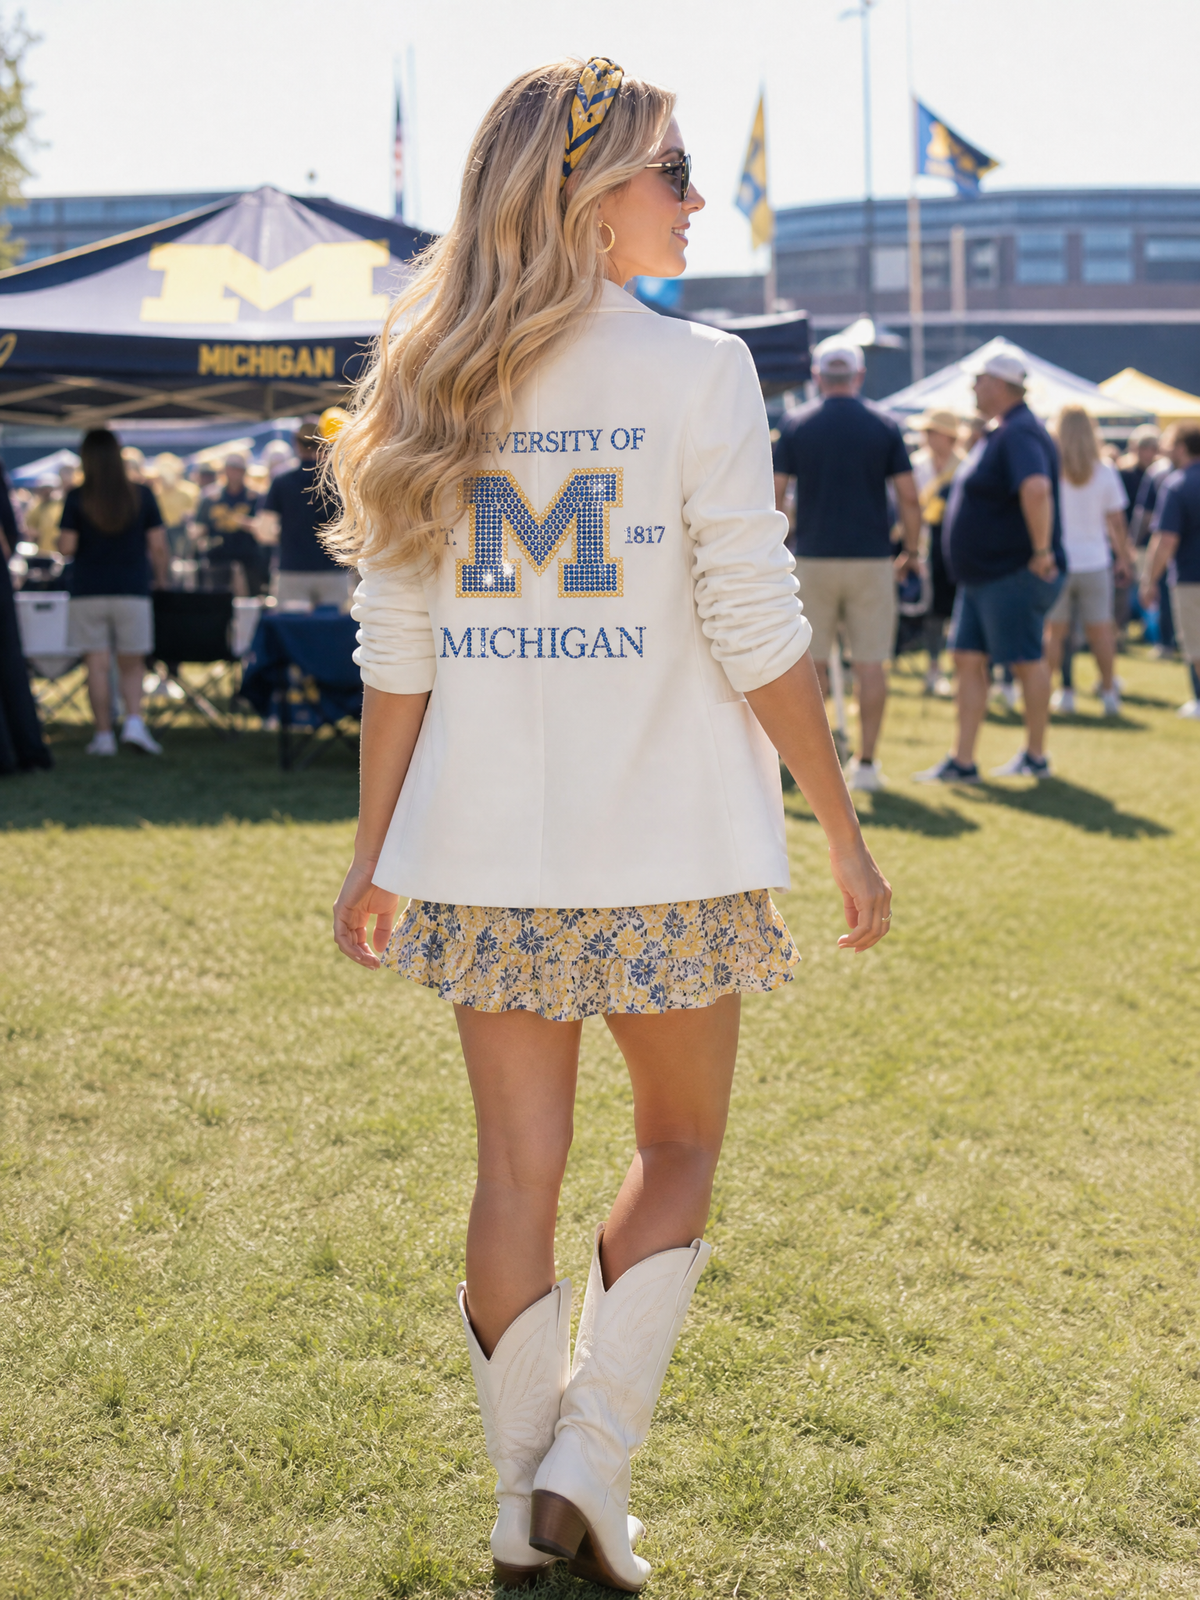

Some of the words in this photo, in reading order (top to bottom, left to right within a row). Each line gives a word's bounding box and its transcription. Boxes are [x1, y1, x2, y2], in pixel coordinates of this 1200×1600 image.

[140, 239, 390, 323] M
[199, 344, 335, 378] MICHIGAN
[479, 429, 603, 453] IVERSITY
[610, 427, 646, 450] OF
[455, 466, 624, 598] M
[624, 525, 666, 544] 1817
[439, 626, 647, 659] MICHIGAN
